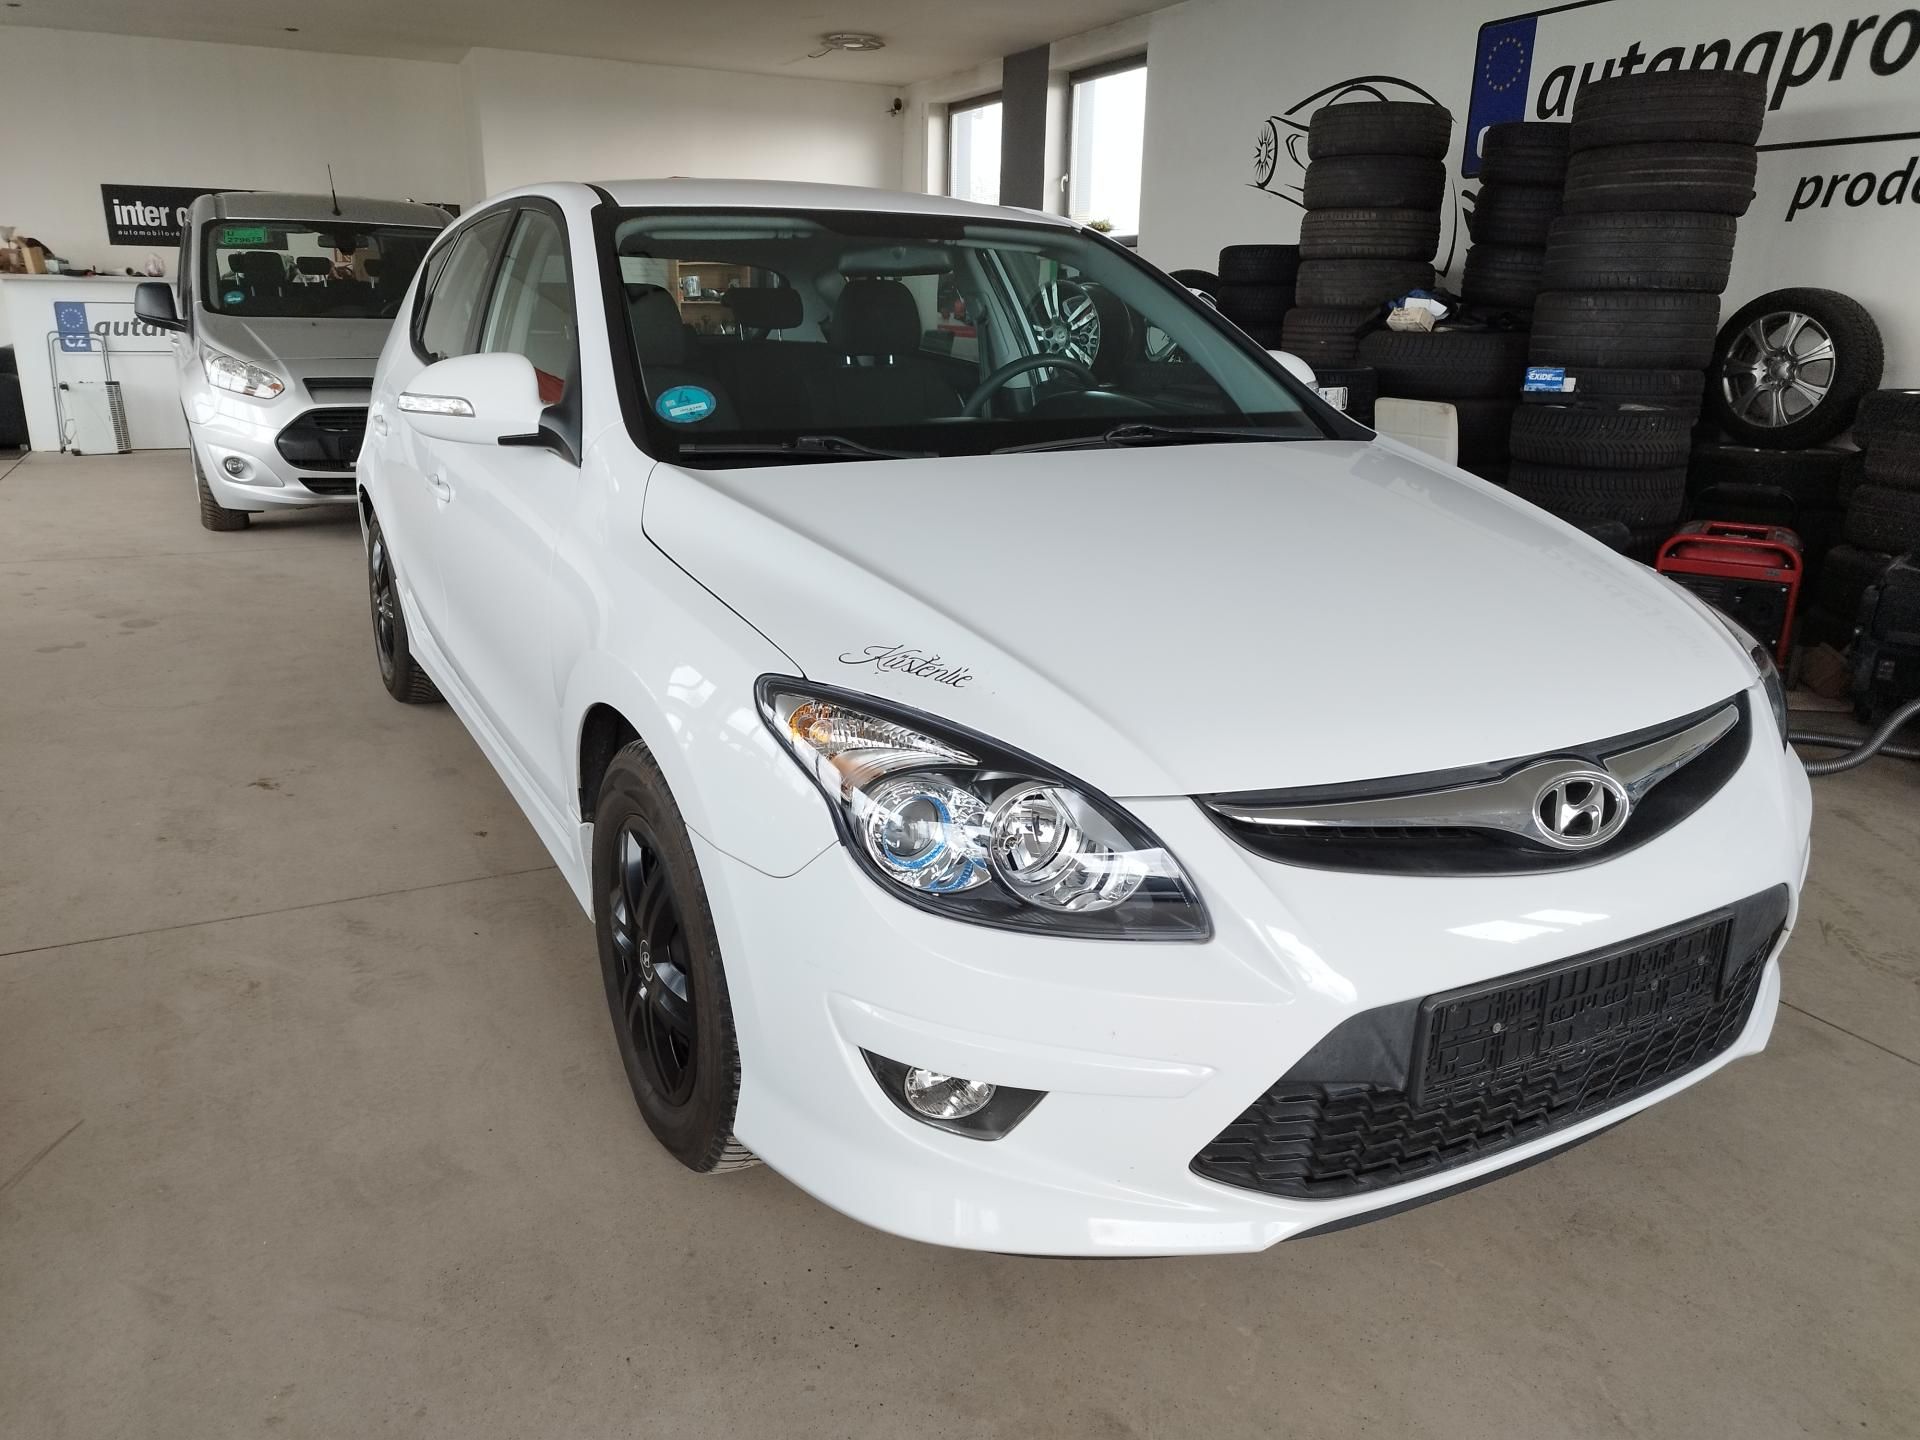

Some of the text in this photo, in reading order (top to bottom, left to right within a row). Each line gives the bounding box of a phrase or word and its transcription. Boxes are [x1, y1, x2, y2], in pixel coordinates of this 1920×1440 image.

[113, 198, 170, 227] inter
[94, 317, 167, 337] auta
[65, 335, 88, 348] CZ
[1528, 373, 1552, 381] EXIDE
